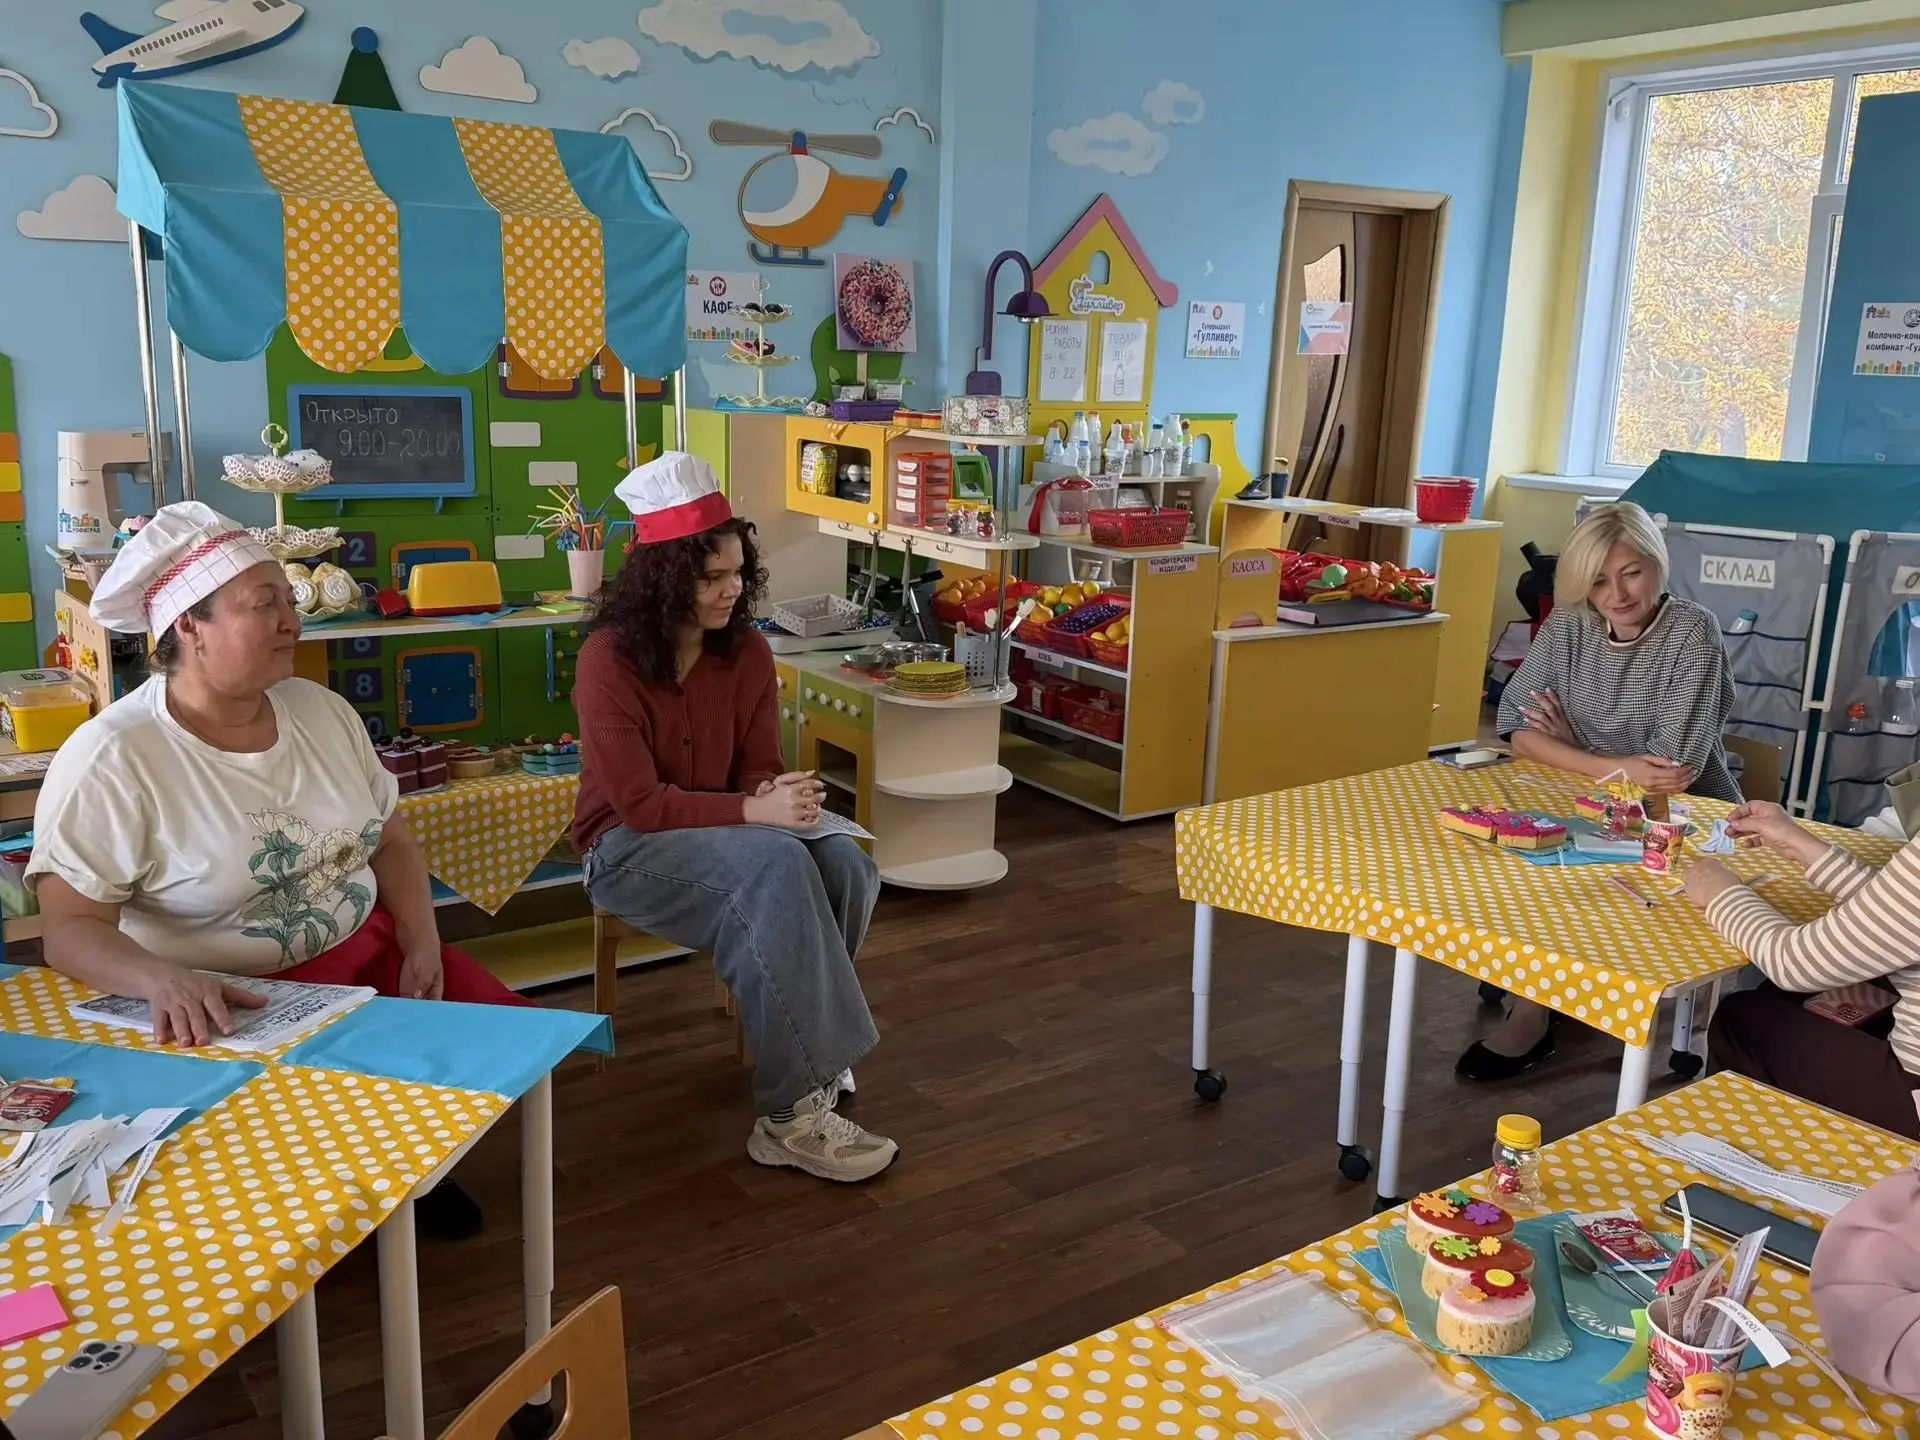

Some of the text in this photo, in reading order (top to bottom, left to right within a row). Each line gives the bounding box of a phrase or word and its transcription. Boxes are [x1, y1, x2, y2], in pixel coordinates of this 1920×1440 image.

[1193, 329, 1238, 344] «Гулливер»
[1865, 343, 1904, 351] комбинат
[349, 538, 366, 562] 2
[1231, 560, 1265, 573] КАССА
[1703, 560, 1772, 583] СКЛАД
[356, 673, 373, 698] 8
